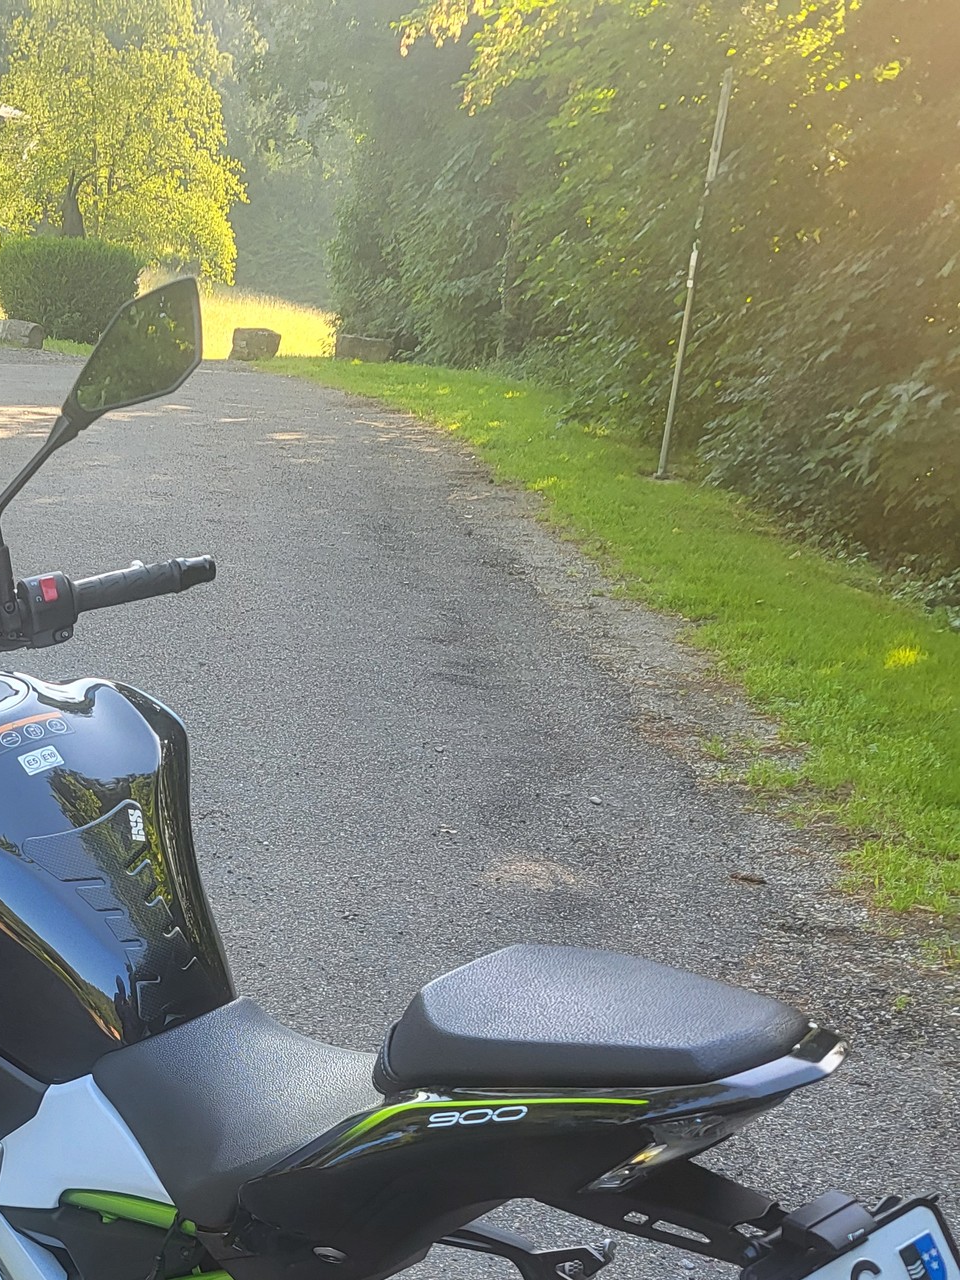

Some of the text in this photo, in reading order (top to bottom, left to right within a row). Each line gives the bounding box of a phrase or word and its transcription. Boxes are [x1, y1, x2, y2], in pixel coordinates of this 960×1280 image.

[26, 751, 56, 767] E5 E10
[427, 1106, 528, 1128] 900
